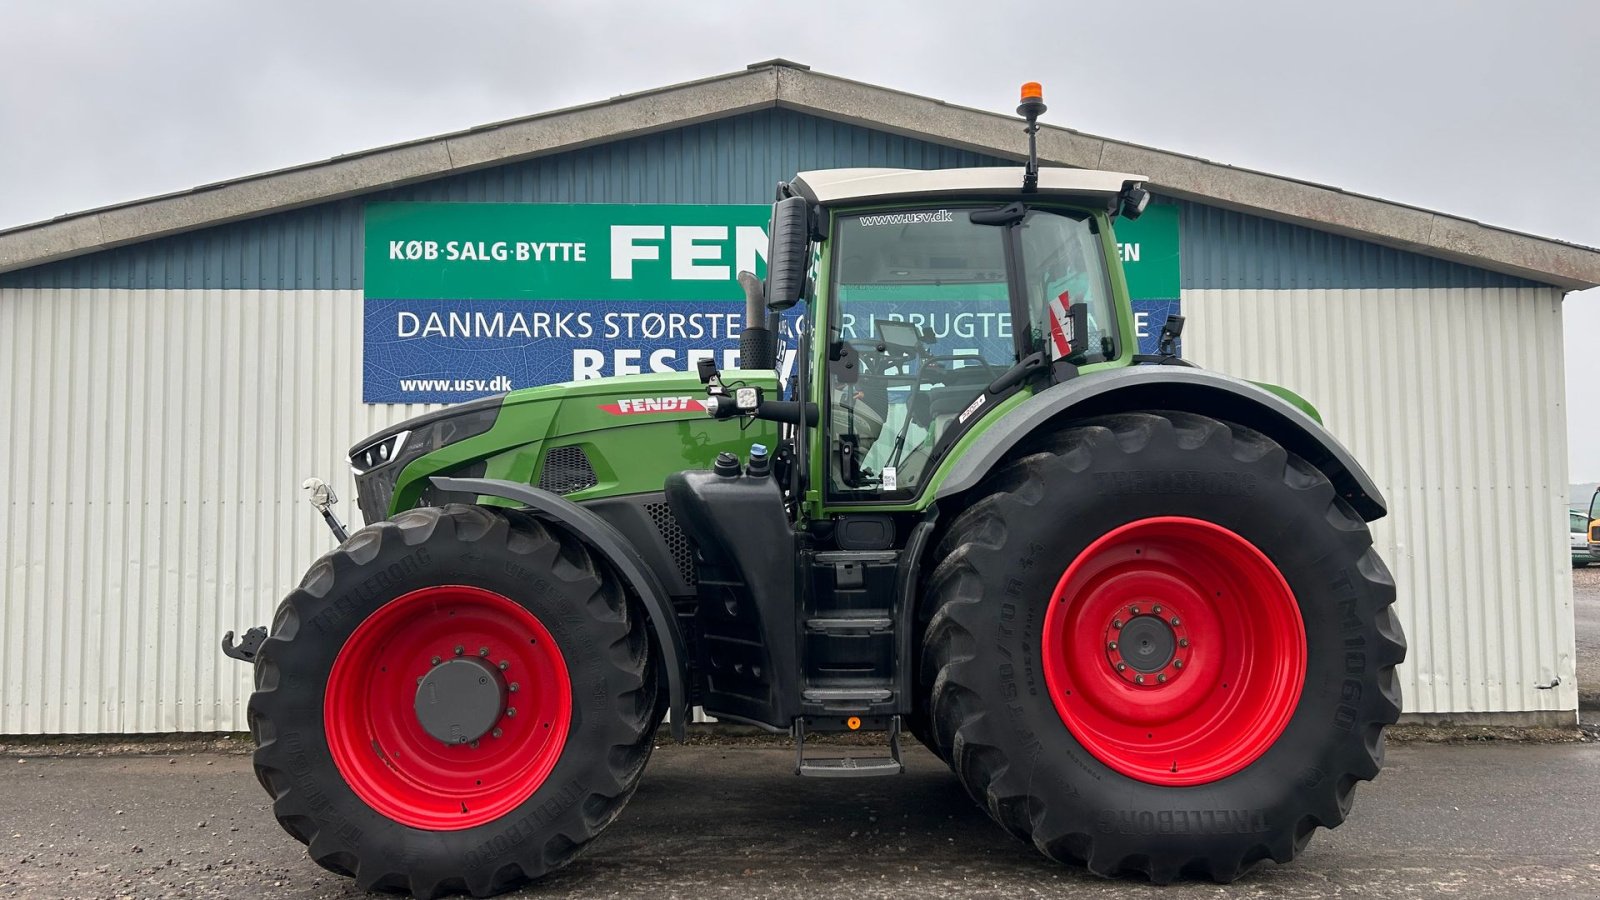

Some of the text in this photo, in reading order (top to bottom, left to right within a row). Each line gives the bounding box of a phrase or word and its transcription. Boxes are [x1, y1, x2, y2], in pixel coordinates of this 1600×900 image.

[859, 210, 953, 226] www.usv.dk
[397, 312, 741, 339] DANMARKS STØRSTE
[400, 375, 512, 392] www.usv.dk
[617, 396, 693, 413] FENDT
